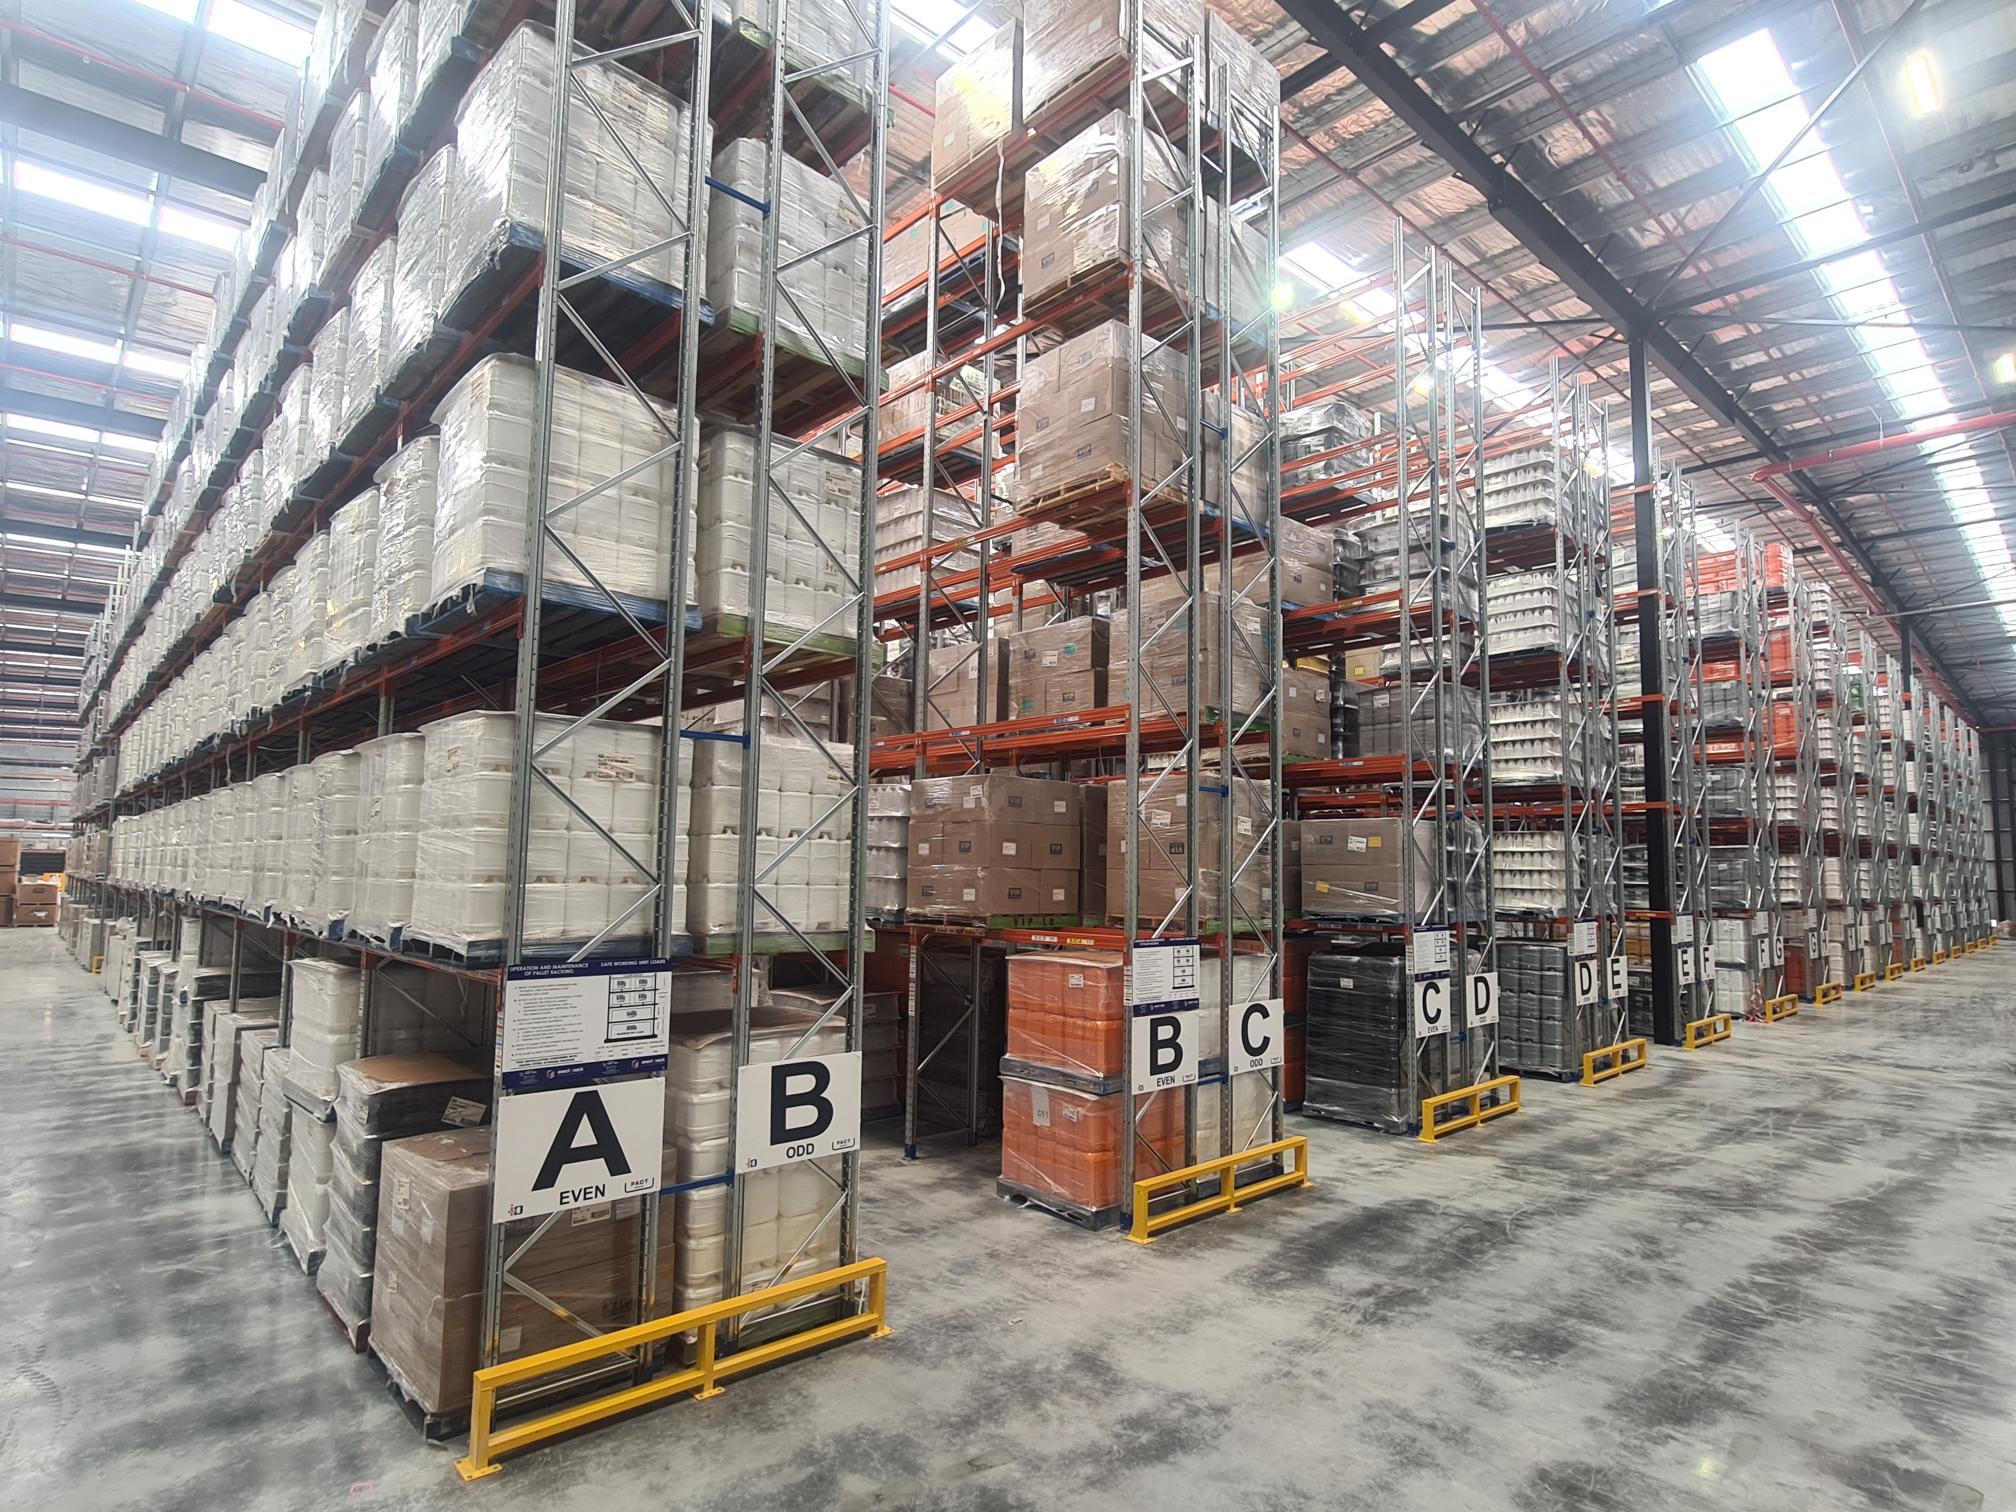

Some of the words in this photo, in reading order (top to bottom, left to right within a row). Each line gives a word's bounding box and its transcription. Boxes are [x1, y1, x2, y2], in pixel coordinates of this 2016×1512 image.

[1681, 948, 1690, 977] E
[1702, 946, 1710, 973] F
[1759, 939, 1765, 963] F
[1775, 937, 1782, 960] G
[1580, 962, 1593, 996] D
[1610, 958, 1622, 990] E
[1422, 981, 1442, 1025] C
[1473, 975, 1491, 1016] D
[1241, 1003, 1271, 1058] C
[1150, 1016, 1184, 1077] B
[1250, 1058, 1264, 1068] ODD
[1156, 1076, 1176, 1087] EVEN
[770, 1061, 834, 1146] B
[531, 1090, 632, 1192] A
[786, 1143, 815, 1159] ODD
[559, 1183, 606, 1206] EVEN
[630, 1178, 649, 1187] PACT
